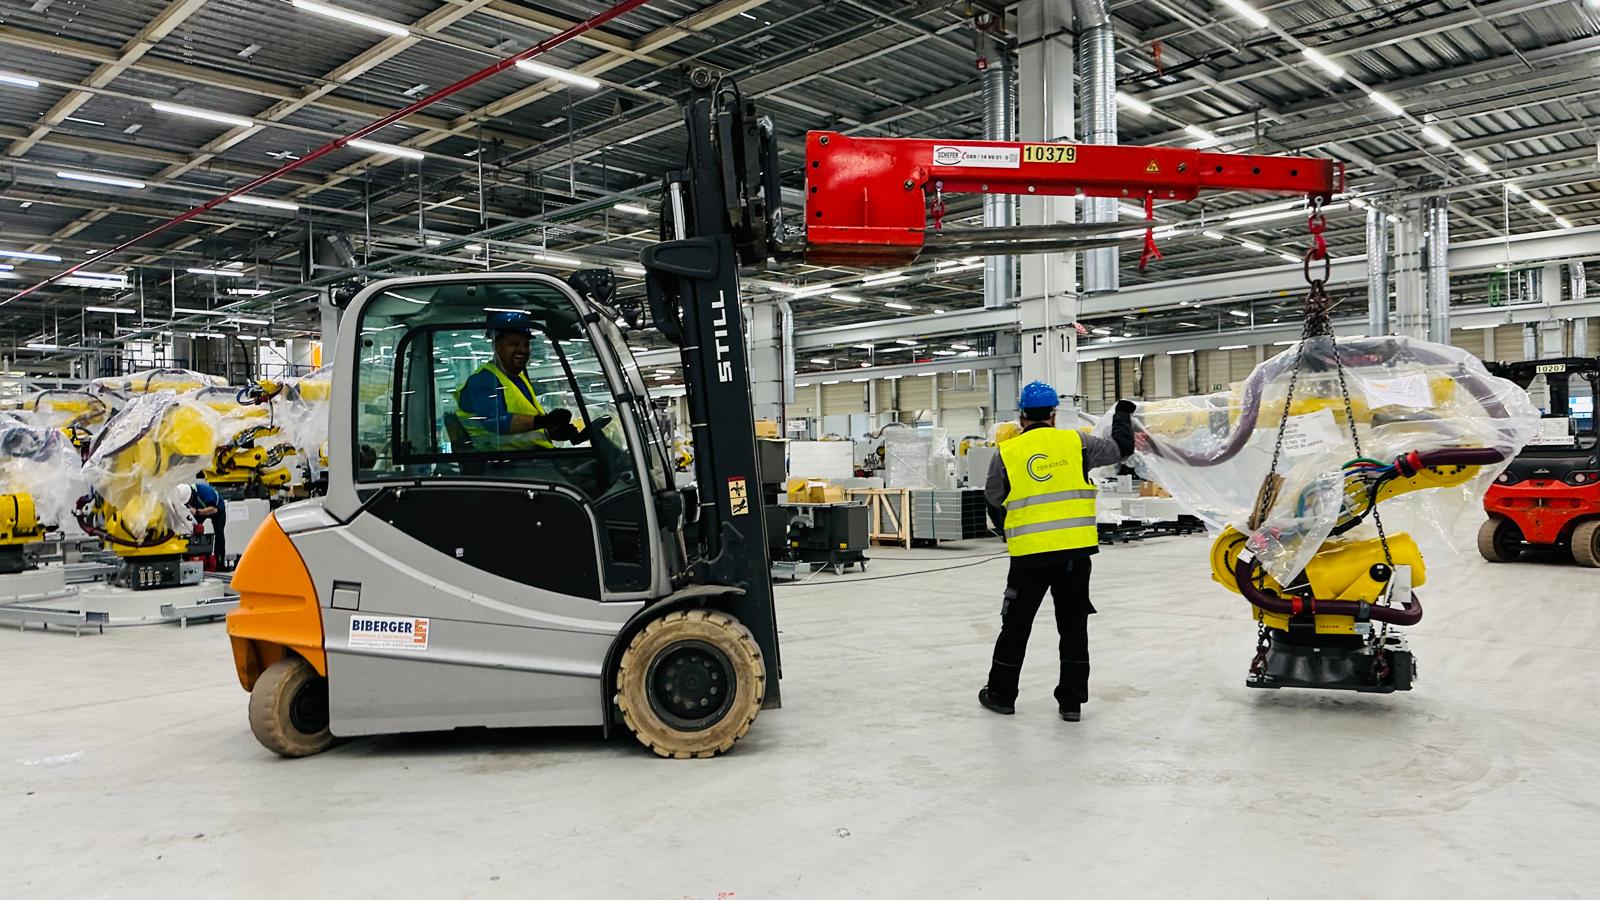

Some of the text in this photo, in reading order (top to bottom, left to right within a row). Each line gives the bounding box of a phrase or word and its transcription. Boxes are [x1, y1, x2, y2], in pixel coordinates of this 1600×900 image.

[937, 151, 959, 159] SCHEFER
[1025, 146, 1075, 162] 10379
[711, 290, 733, 382] STILL
[1033, 333, 1070, 354] F 11
[1537, 364, 1565, 373] 10207
[352, 619, 412, 633] BIBERGER
